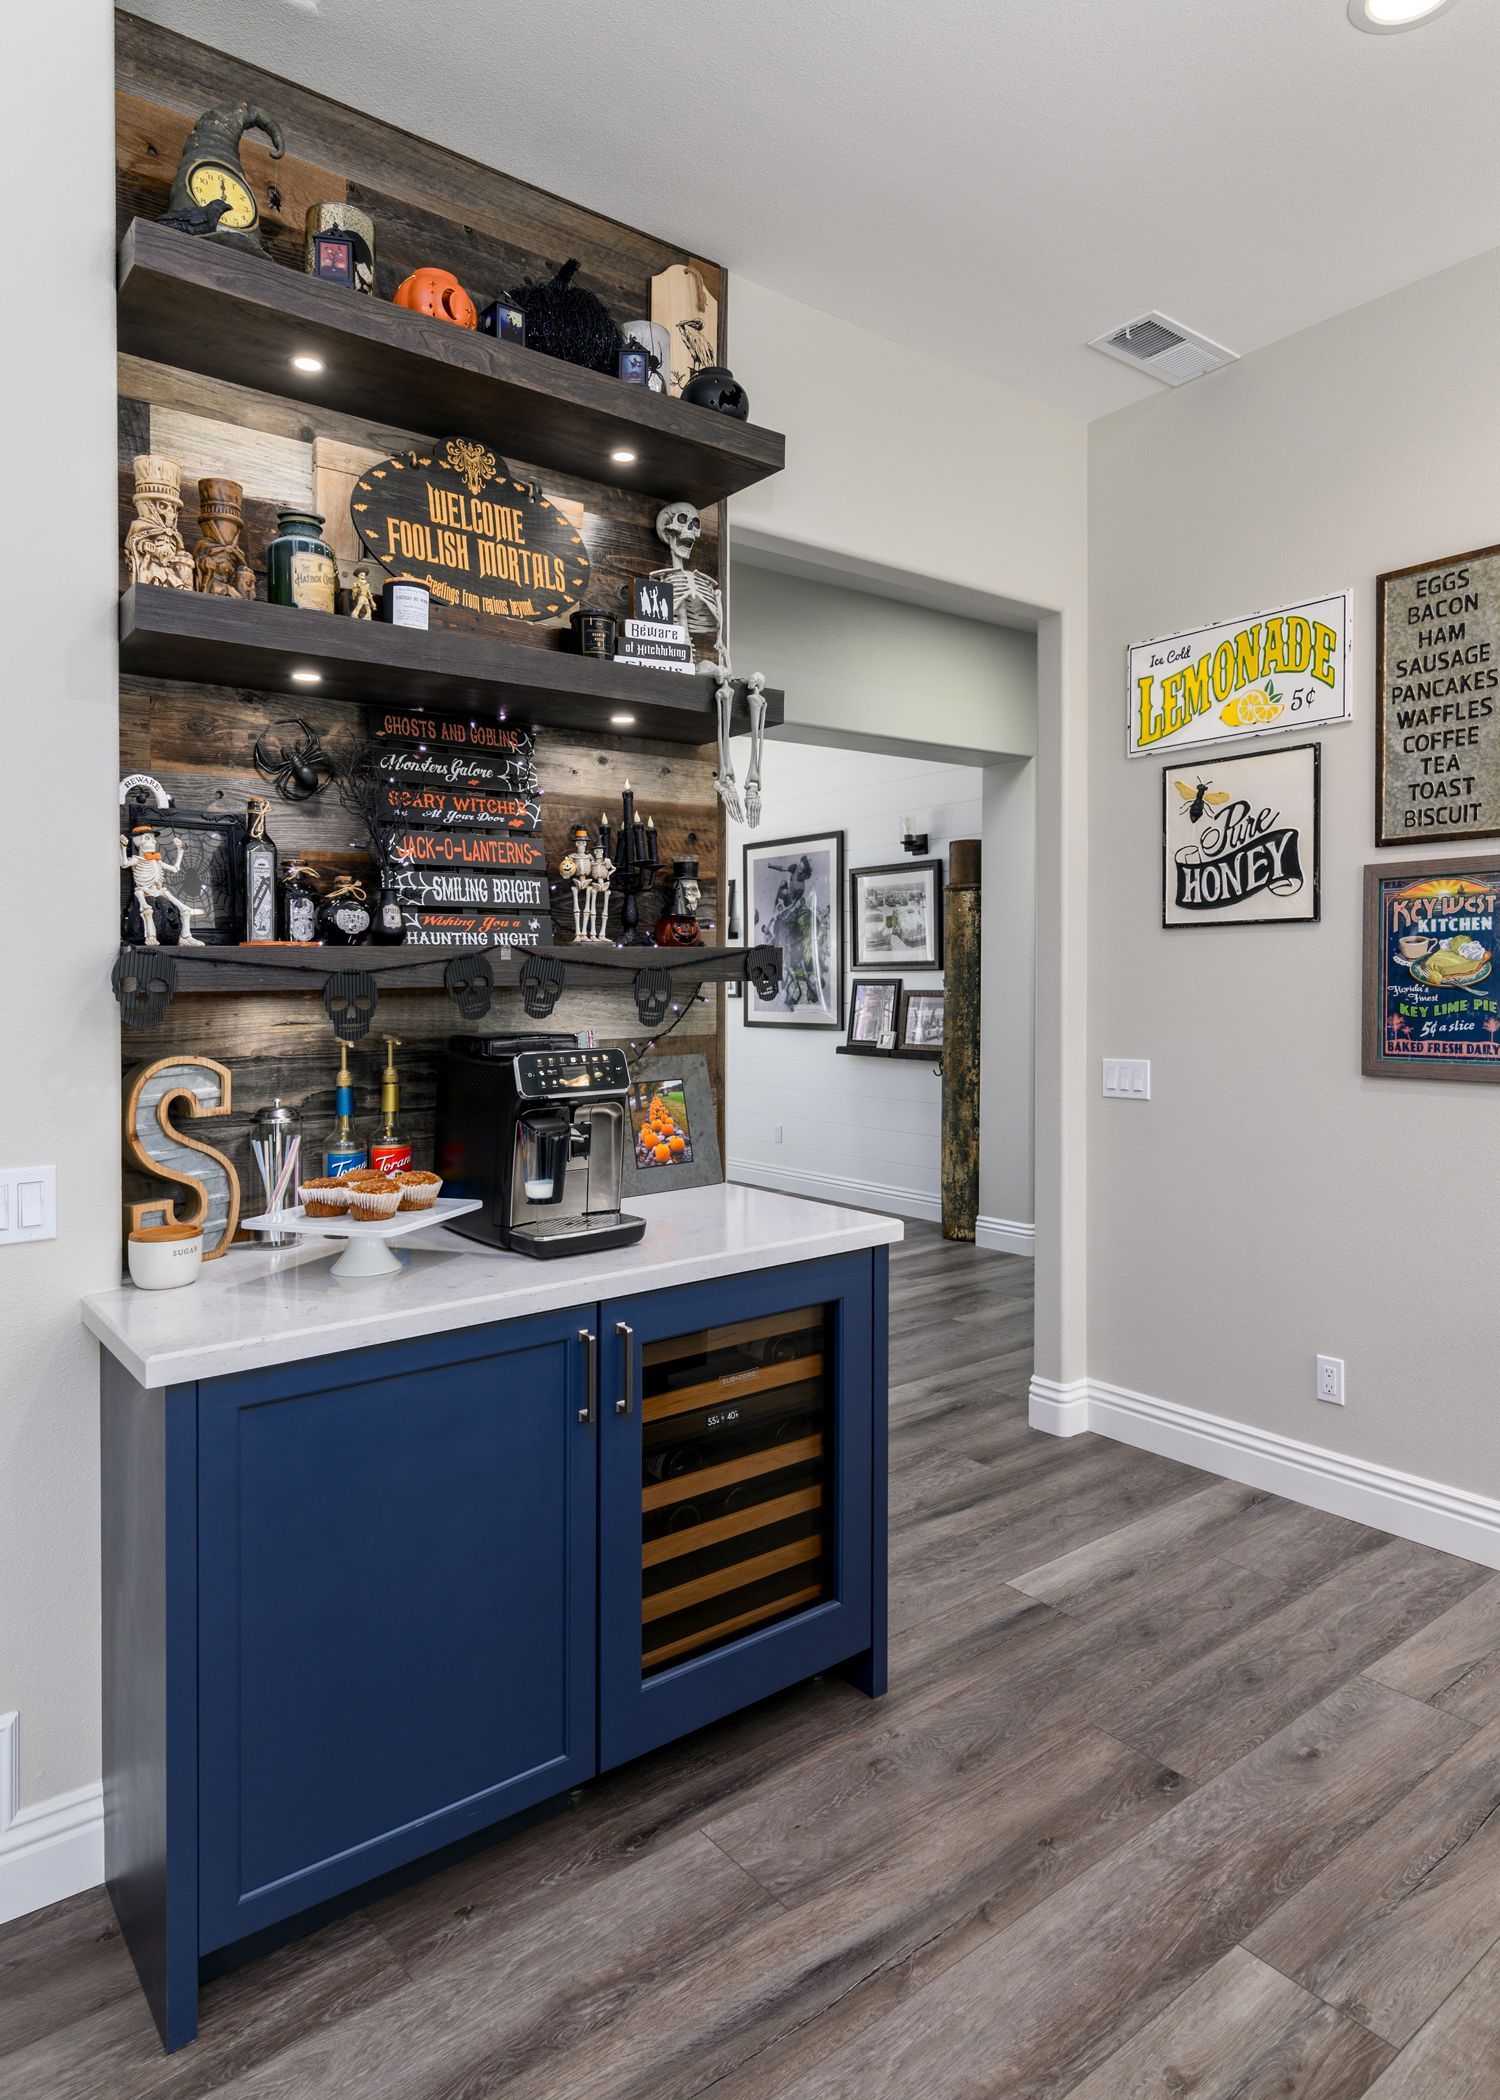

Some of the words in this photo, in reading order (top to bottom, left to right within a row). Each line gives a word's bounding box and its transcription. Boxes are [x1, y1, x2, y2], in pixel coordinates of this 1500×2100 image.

[426, 481, 526, 545] WELCOME
[387, 517, 470, 571] FOOLISH
[477, 538, 566, 593] MORTALS
[1416, 568, 1470, 599] EGGS
[462, 589, 480, 612] from
[482, 596, 508, 616] regions
[1408, 593, 1479, 625] BACON
[631, 623, 678, 640] Beware
[1418, 623, 1466, 649] HAM
[625, 642, 634, 653] of
[636, 643, 687, 660] Hitchhiking
[1150, 654, 1165, 668] Ice
[1166, 645, 1191, 664] Cold
[1396, 643, 1491, 678] SAUSAGE
[1137, 616, 1337, 748] LEMONADE
[1391, 668, 1499, 705] PANCAKES
[1290, 687, 1316, 711] 5¢
[1396, 697, 1493, 730] WAFFLES
[384, 715, 437, 739] GHOSTS
[441, 722, 466, 743] AND
[470, 728, 520, 748] GOBLINS
[1403, 726, 1480, 753] COFFEE
[380, 754, 448, 774] Monsters
[445, 759, 494, 782] Galore
[1420, 754, 1460, 775] TEA
[124, 775, 161, 792] BEWARE
[1408, 776, 1476, 801] TOAST
[388, 790, 447, 810] SCARY
[452, 796, 527, 816] WITCHES
[422, 808, 441, 818] At
[443, 810, 474, 823] Your
[476, 811, 505, 823] Door
[1404, 803, 1482, 828] BISCUIT
[1200, 800, 1281, 857] Pure
[398, 835, 533, 866] JACK-O-LANTERNS
[1182, 831, 1294, 903] HONEY
[432, 875, 488, 903] SMILING
[492, 878, 541, 904] BRIGHT
[419, 915, 476, 932] Wishing
[478, 916, 509, 933] You
[512, 920, 521, 928] a
[1393, 898, 1437, 933] KEY
[1442, 894, 1497, 915] WEST
[1418, 916, 1493, 933] KITCHEN
[407, 931, 488, 946] HAUNTING
[494, 932, 539, 946] NIGHT
[1387, 984, 1429, 997] Florida's
[1407, 993, 1439, 1005] Finest
[1399, 1003, 1429, 1018] KEY
[1433, 999, 1468, 1016] LIME
[1473, 998, 1498, 1014] PIE
[1420, 1020, 1438, 1037] 5¢
[1448, 1020, 1475, 1032] slice
[1387, 1041, 1424, 1052] BAKED
[1427, 1043, 1463, 1054] FRESH
[1466, 1044, 1500, 1056] DAILY
[172, 1245, 198, 1257] SUGAR
